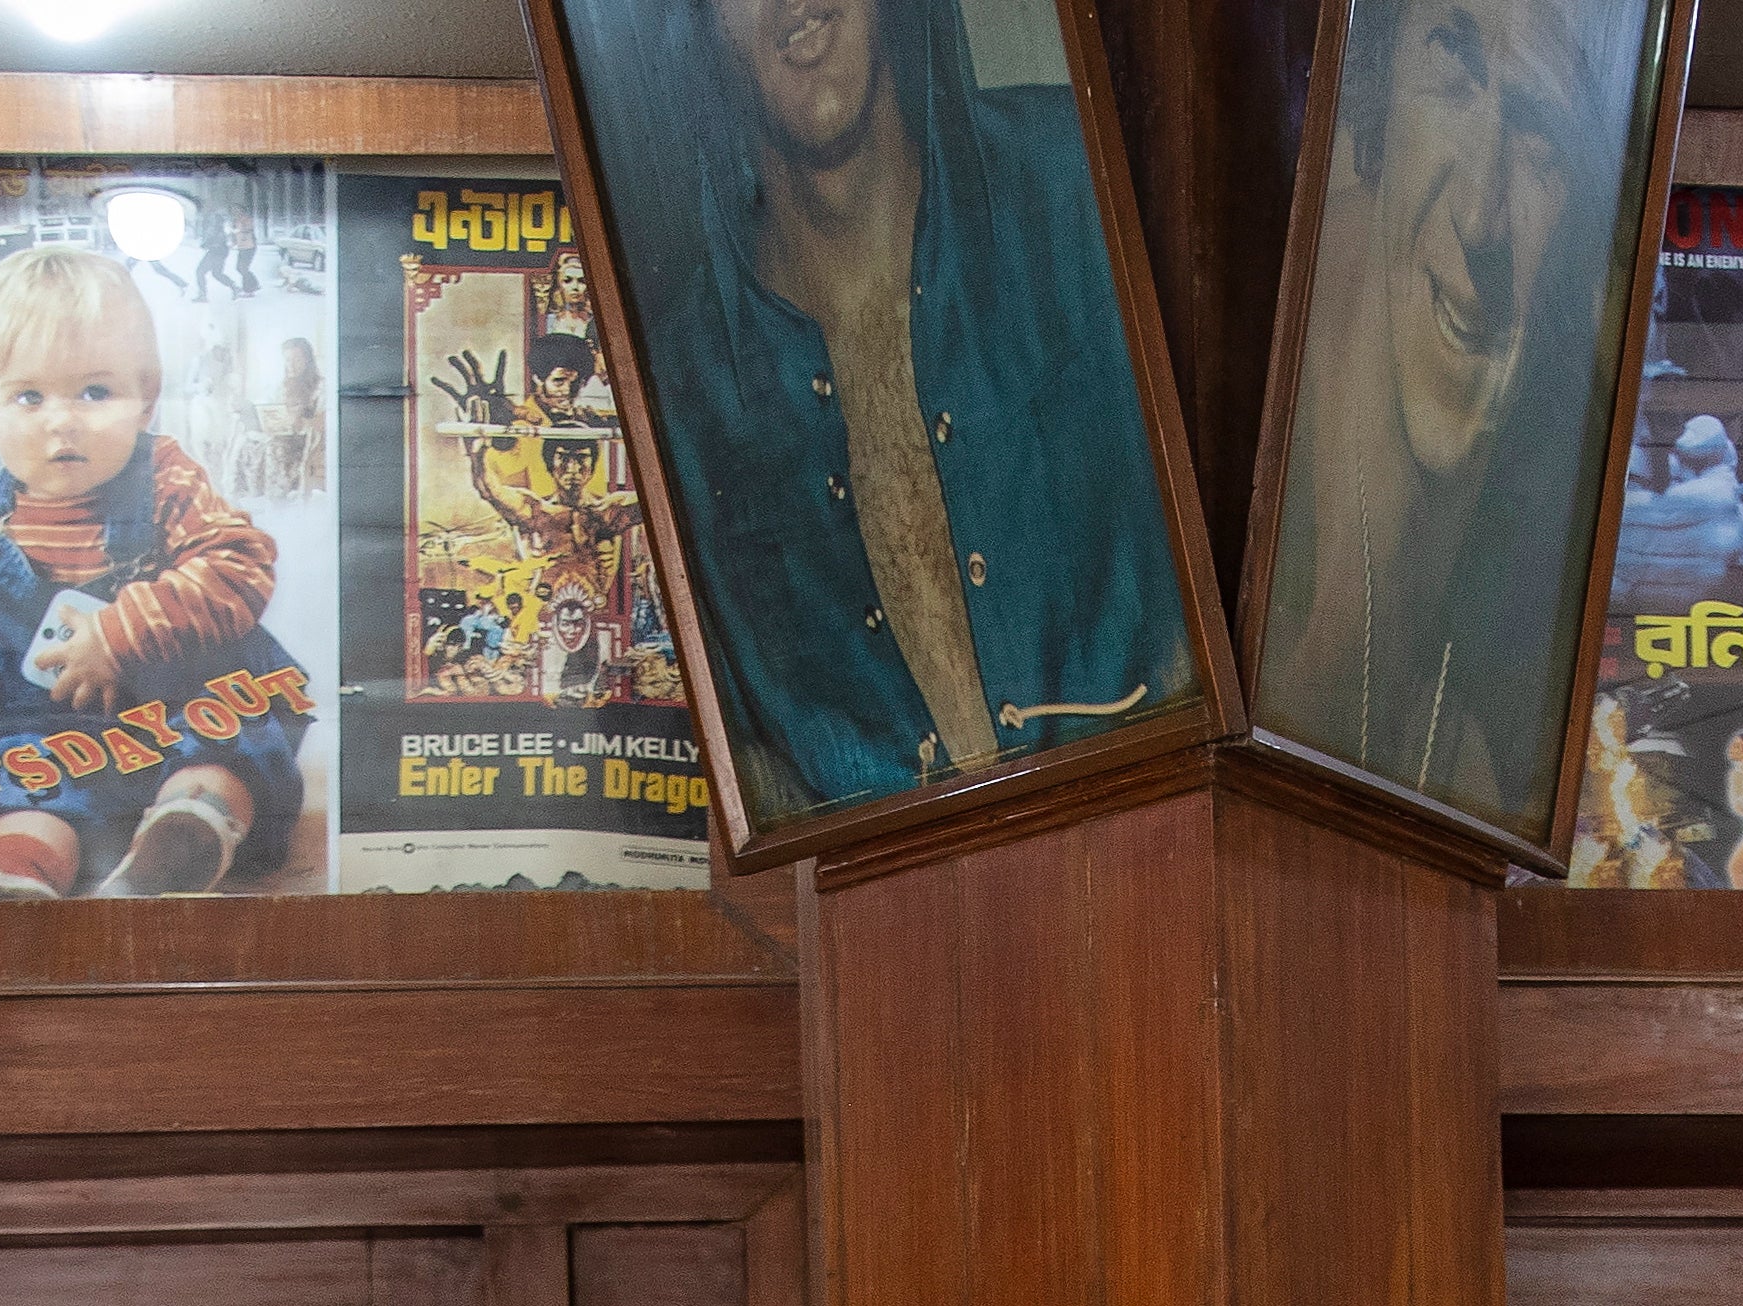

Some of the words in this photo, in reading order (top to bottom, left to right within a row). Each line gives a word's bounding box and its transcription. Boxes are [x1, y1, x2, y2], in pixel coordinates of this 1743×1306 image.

[1687, 253, 1704, 268] AN
[183, 666, 316, 741] OUT
[401, 733, 500, 758] BRUCE
[504, 732, 553, 757] LEE
[571, 732, 622, 756] JIM
[624, 736, 700, 764] KELLY
[399, 756, 500, 797] Enter
[517, 756, 588, 797] The
[602, 758, 710, 814] Drago
